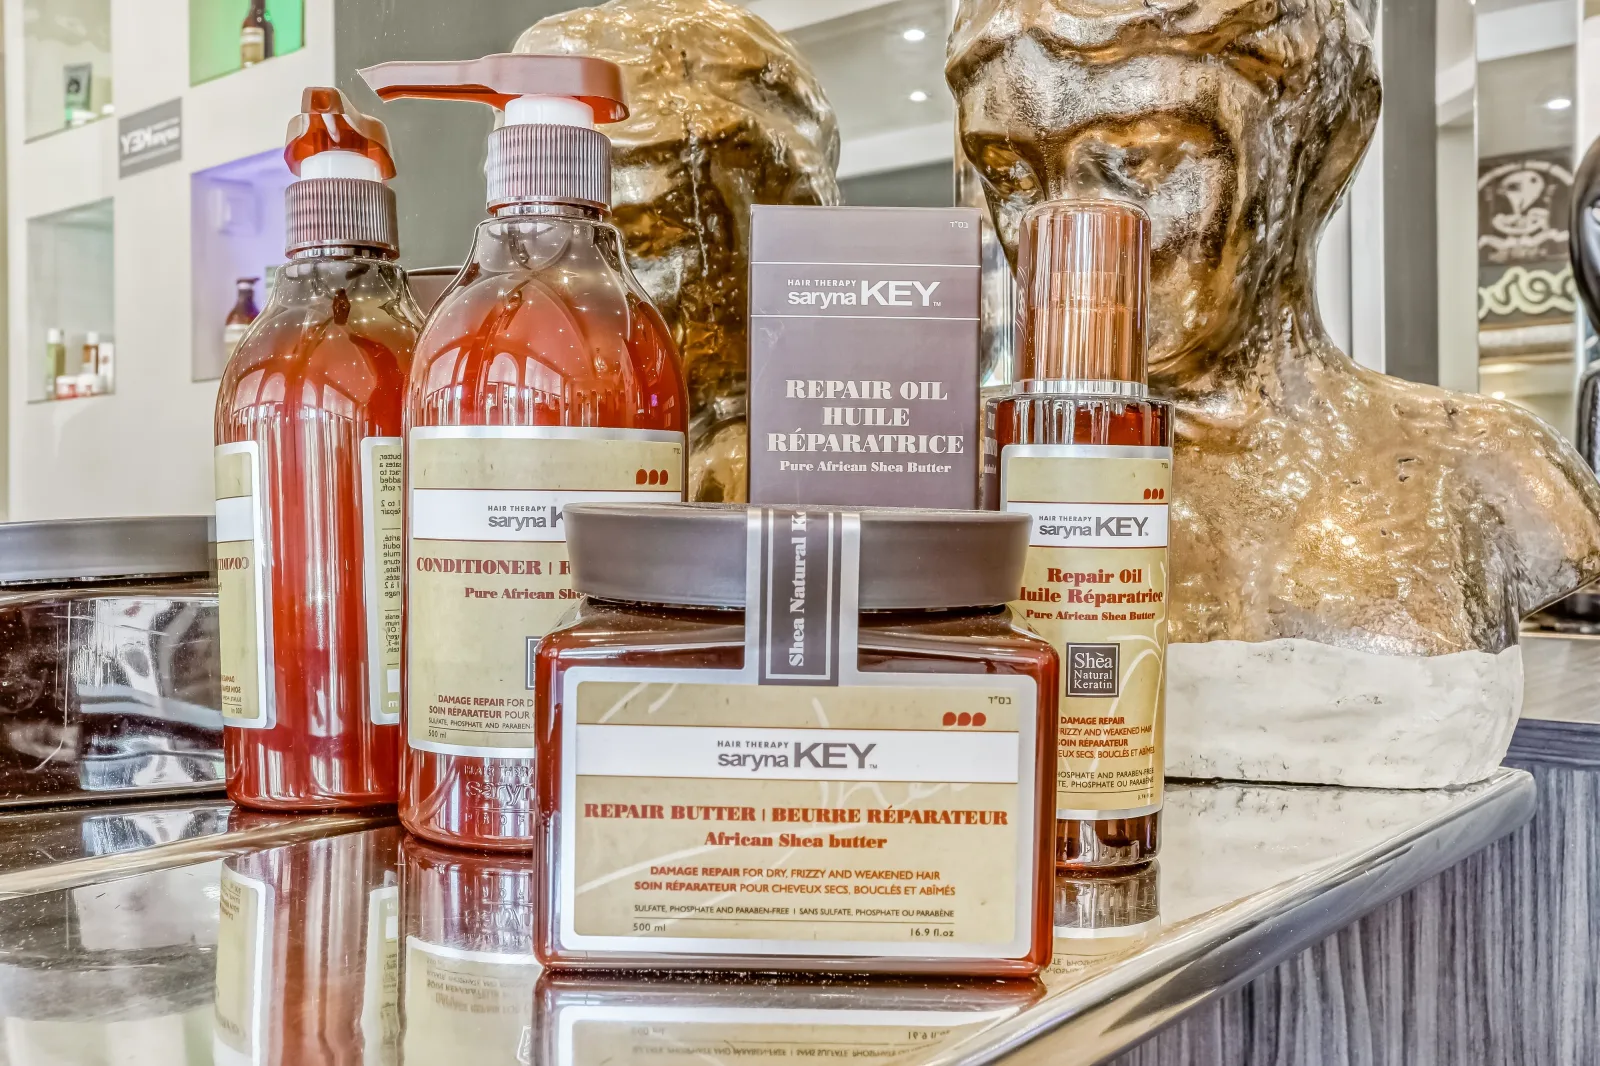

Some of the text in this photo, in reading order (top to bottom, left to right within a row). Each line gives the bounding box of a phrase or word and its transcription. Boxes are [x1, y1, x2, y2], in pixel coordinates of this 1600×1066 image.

[787, 278, 857, 287] HAIR THERAPY
[787, 291, 857, 310] saryna
[785, 379, 948, 401] REPAIR OIL
[822, 406, 910, 427] HUILE
[766, 428, 964, 454] RÉPARATRICE
[779, 460, 952, 474] Pure African Shea Butter
[487, 514, 546, 531] saryna
[1039, 524, 1091, 539] saryna
[416, 556, 543, 575] CONDITIONER
[789, 536, 807, 614] Natural
[1046, 567, 1143, 587] Repair Oil
[464, 587, 498, 599] Pure
[501, 587, 555, 600] African
[1067, 587, 1164, 608] Réparatrice
[1026, 609, 1156, 621] Pure African Shea Butter
[788, 617, 805, 667] Shea
[1074, 670, 1113, 680] Natural
[1073, 679, 1113, 689] Keratin
[438, 694, 472, 706] DAMAGE
[473, 696, 505, 707] REPAIR
[506, 698, 525, 708] FOR
[429, 705, 446, 716] SOIN
[447, 706, 502, 719] RÉPARATEUR
[504, 710, 530, 719] POUR
[450, 719, 483, 729] PHOSPHATE
[502, 722, 533, 730] PARABEN-
[1060, 716, 1125, 725] DAMAGE REPAIR
[428, 729, 447, 739] 500 ml
[1059, 725, 1152, 737] RIZZY AND WEAKENED HAIR
[717, 740, 789, 749] HAIR THERAPY
[1078, 737, 1129, 747] RÉPARATEUR
[1097, 748, 1130, 759] BOUCLÉS
[1130, 748, 1139, 757] ET
[718, 753, 789, 772] saryna
[1097, 771, 1114, 779] AND
[1071, 779, 1115, 789] PHOSPHATE
[1116, 779, 1128, 788] OU
[584, 803, 1009, 825] REPAIR BUTTER BEURRE RÉPARATEUR
[704, 831, 888, 849] African Shea butter
[650, 866, 941, 880] DAMAGE REPAIR FOR DRY, FRIZZY AND WEAKENED HAIR
[634, 880, 956, 896] SOIN RÉPARATEUR POUR CHEVEUX SECS, BOUCLÉS ET ABÎMÉS
[634, 904, 954, 918] SULFATE, PHOSPHATE AND PARABEN-FREE SANS SULFATE, PHOSPHATE OU PARABÈNE
[632, 923, 666, 932] 500 ml
[910, 928, 930, 937] 16.9
